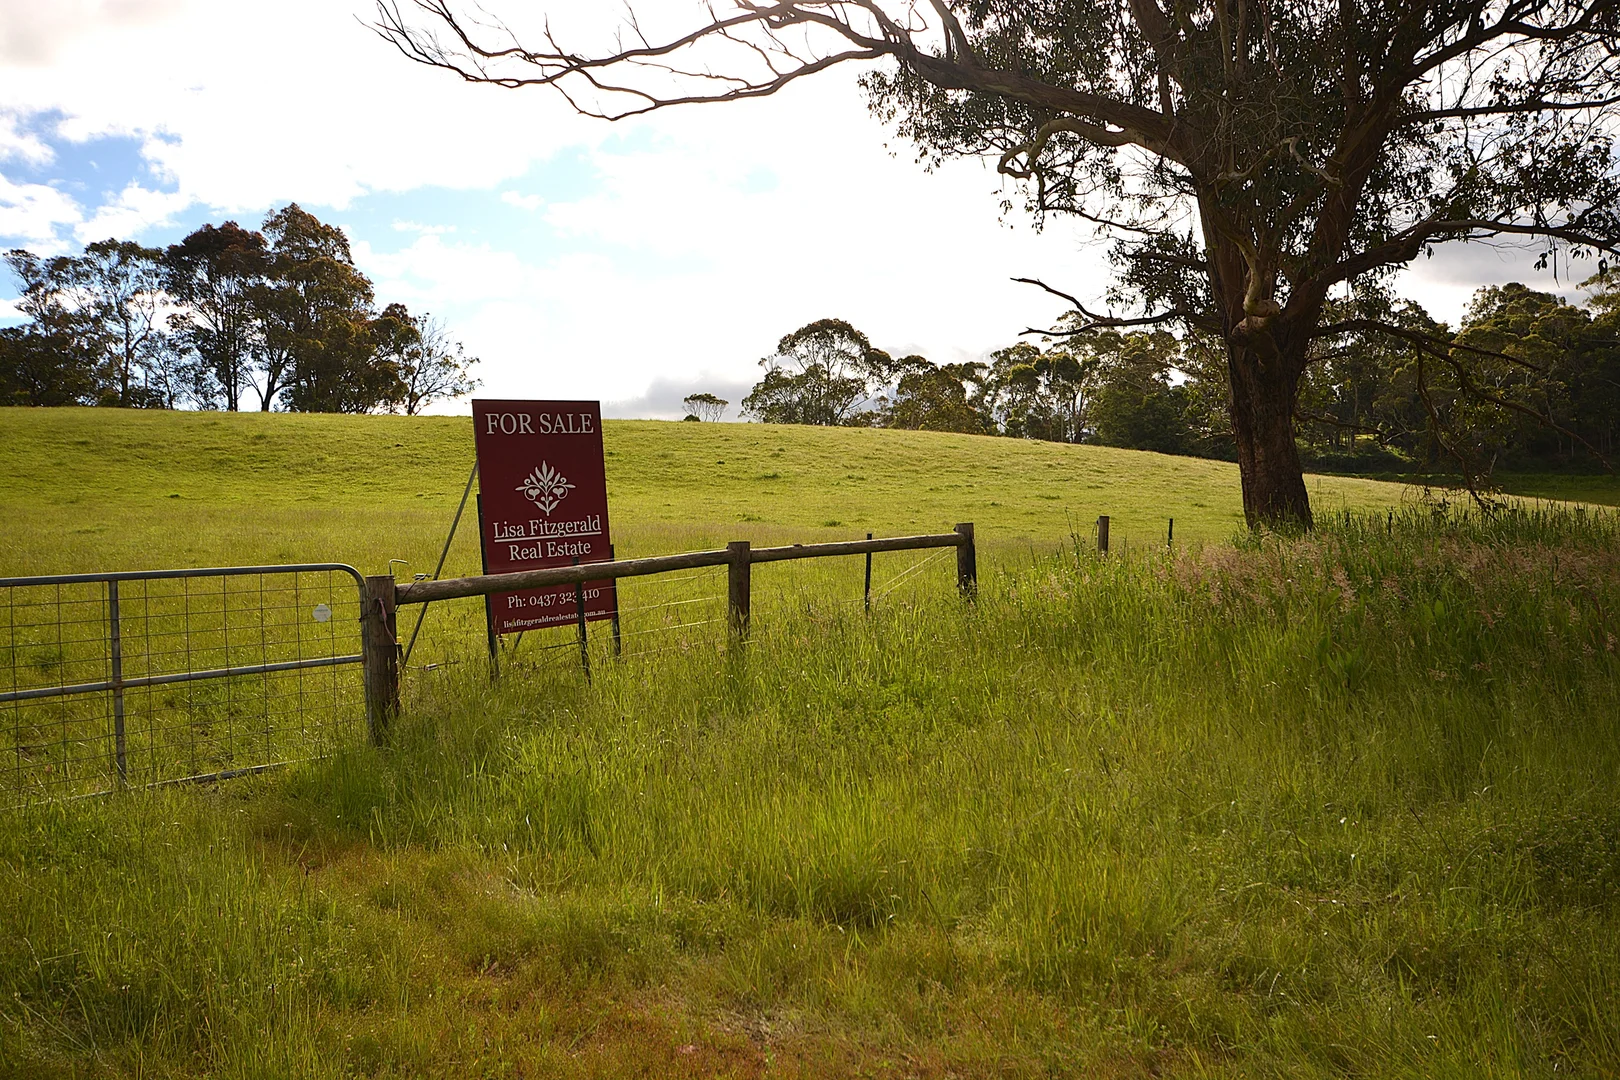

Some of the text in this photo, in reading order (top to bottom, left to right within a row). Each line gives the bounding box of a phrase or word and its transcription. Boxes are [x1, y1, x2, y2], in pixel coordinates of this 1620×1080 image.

[485, 412, 594, 434] FOR SALE
[493, 515, 601, 538] Lisa Fitzgerald
[509, 540, 591, 561] Real Estate
[507, 595, 526, 609] Ph:
[529, 593, 557, 608] 0437
[582, 588, 600, 602] 410
